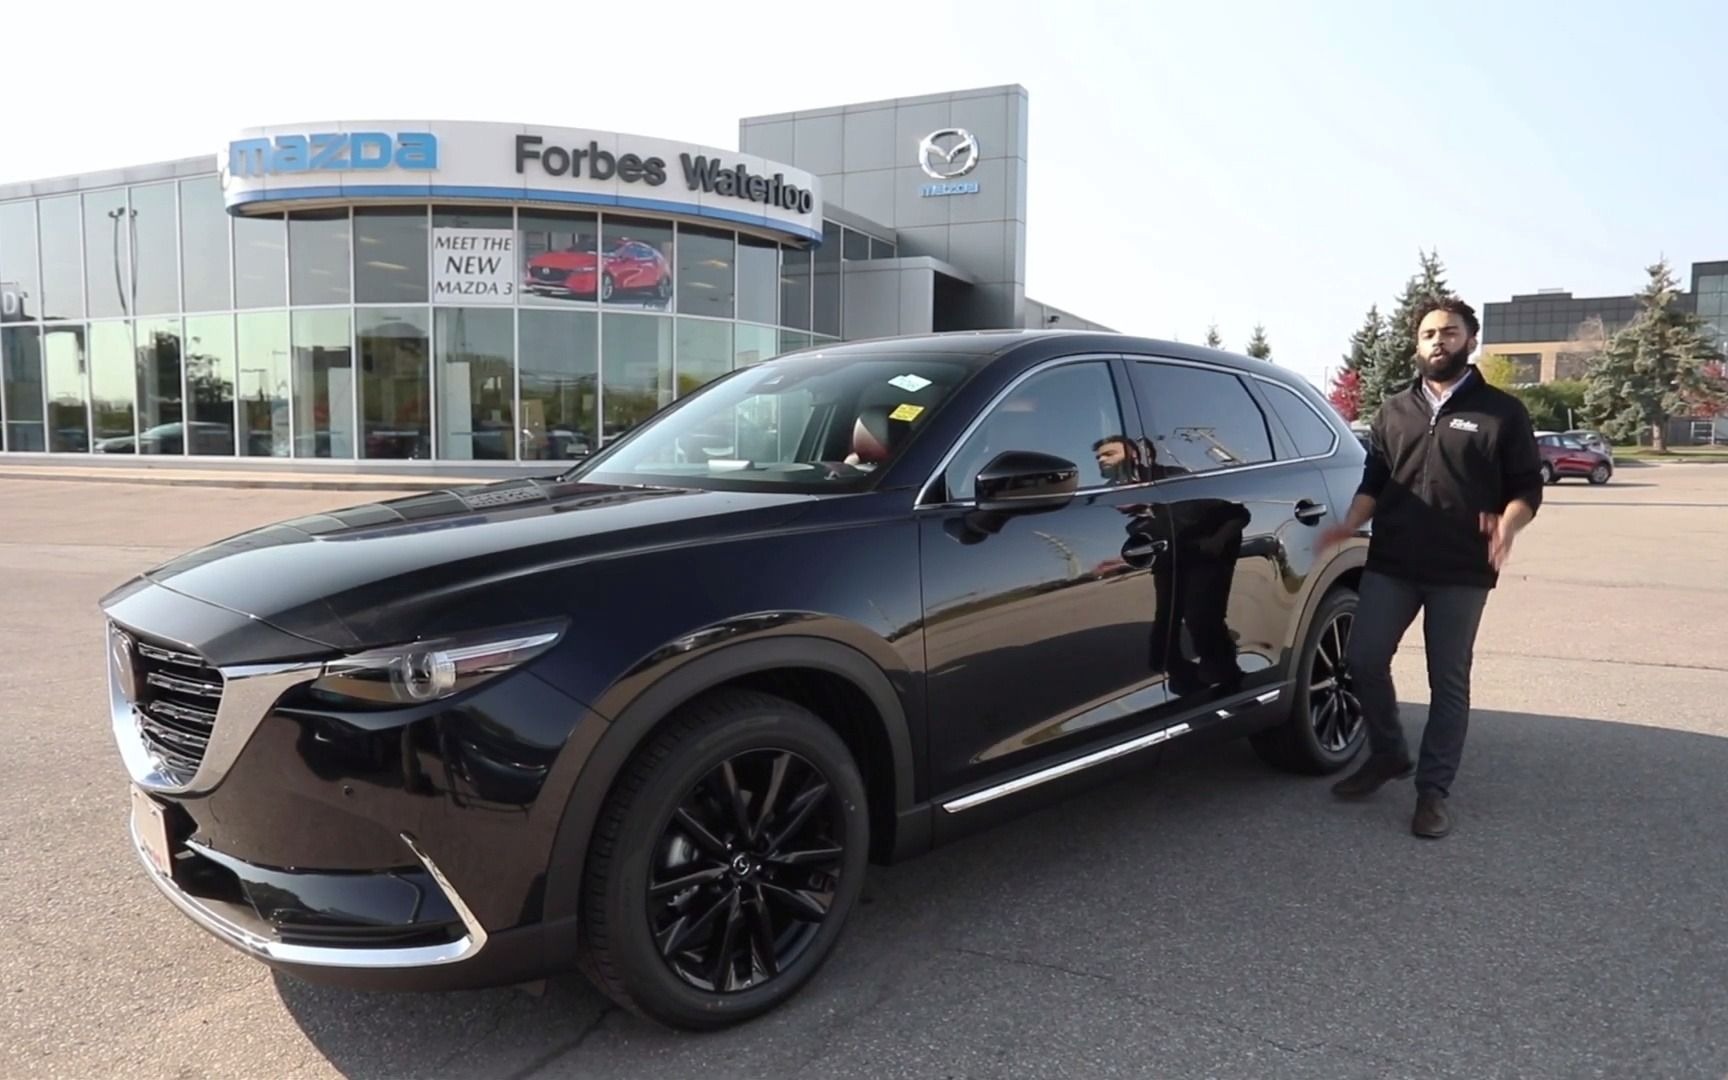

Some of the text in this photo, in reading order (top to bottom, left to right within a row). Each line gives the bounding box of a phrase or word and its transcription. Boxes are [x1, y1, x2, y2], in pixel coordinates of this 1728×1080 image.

[515, 135, 814, 214] Forbes Waterloo
[435, 236, 512, 251] MEET THE
[445, 256, 501, 274] NEW
[435, 281, 513, 295] MAZDA 3
